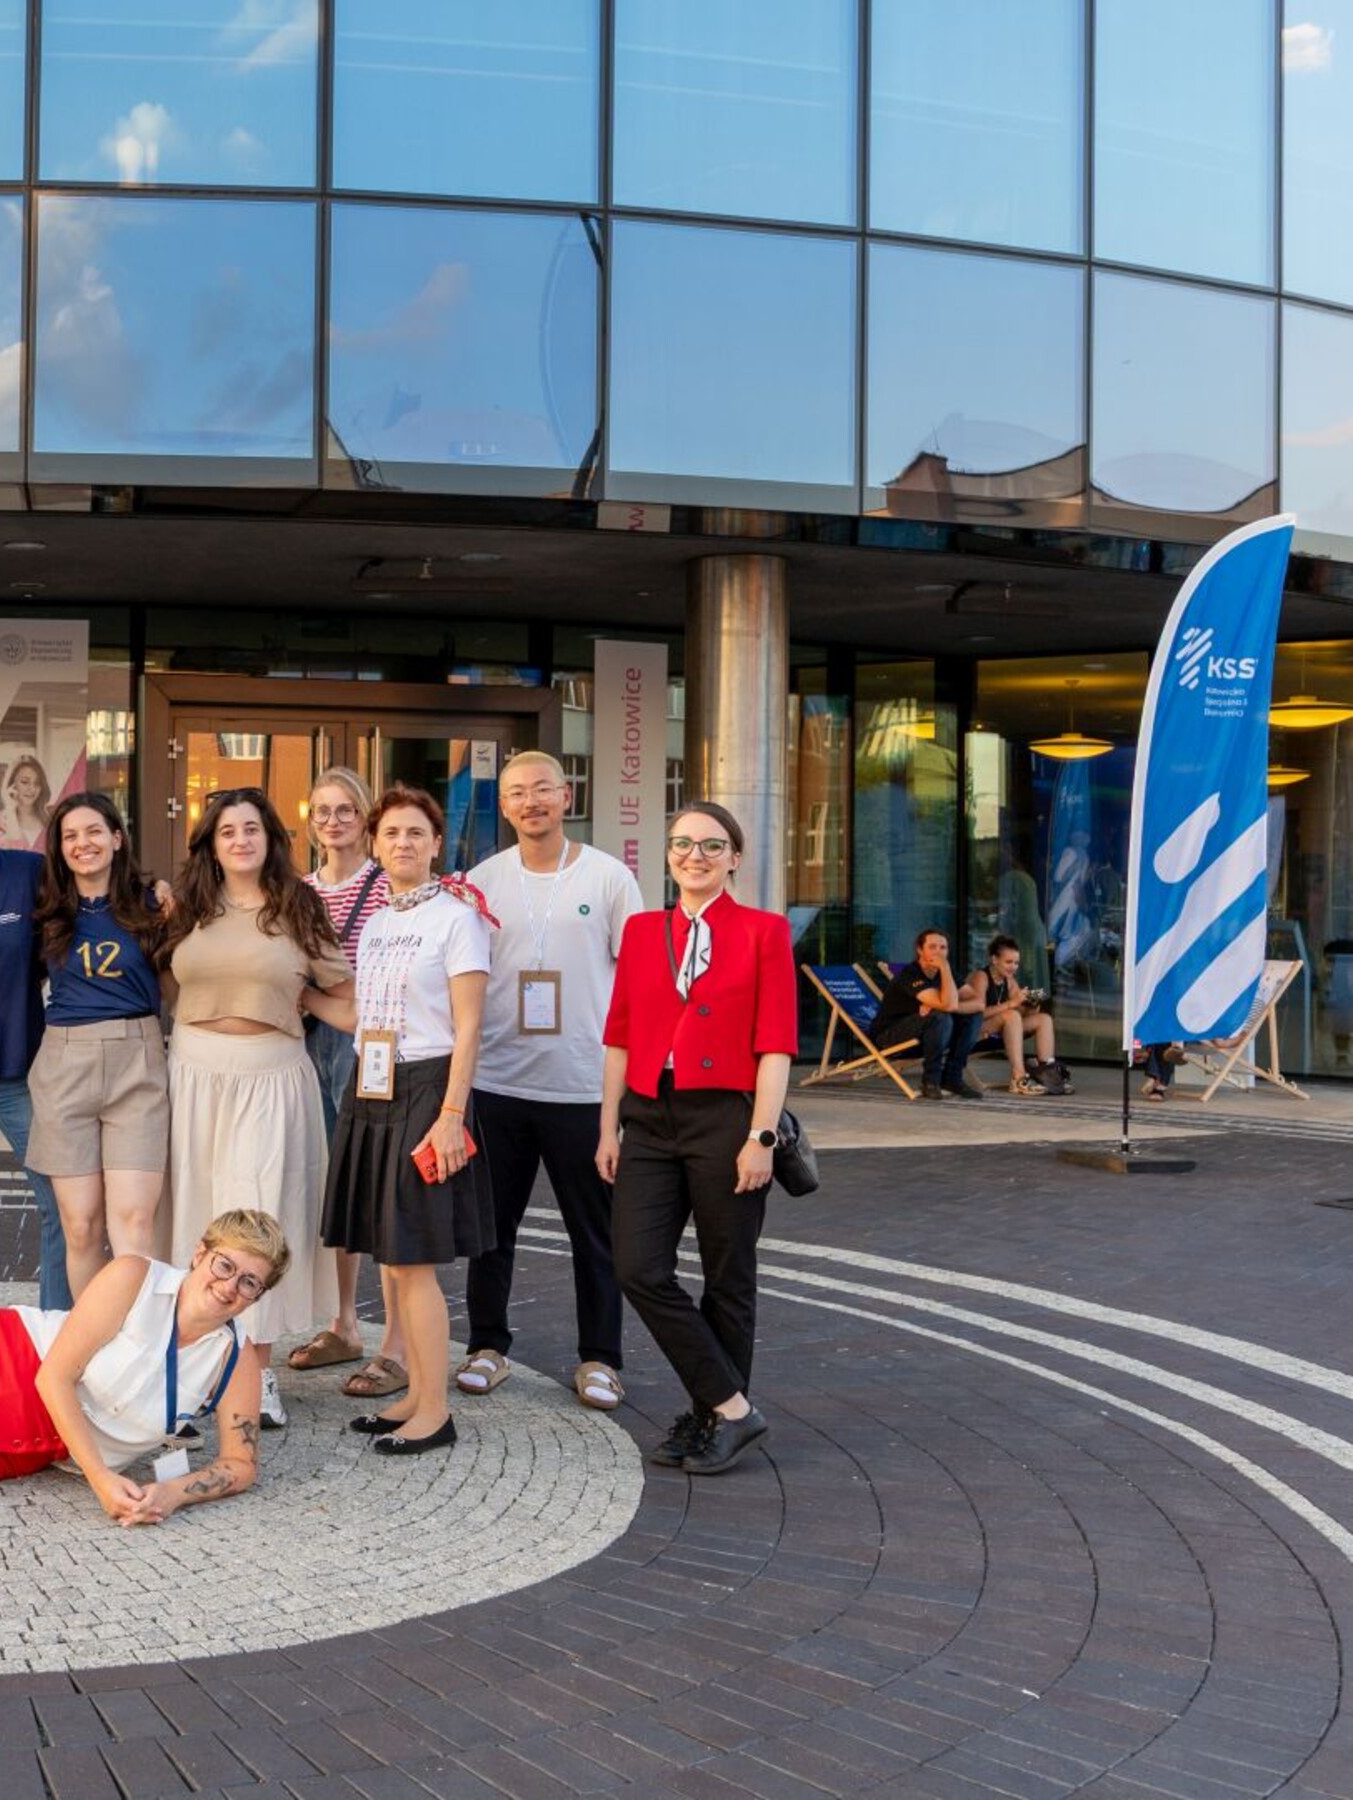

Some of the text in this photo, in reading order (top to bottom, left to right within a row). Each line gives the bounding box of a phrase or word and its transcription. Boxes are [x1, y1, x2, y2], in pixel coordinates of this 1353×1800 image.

[621, 667, 642, 784] Katowice
[620, 796, 640, 825] UE
[76, 941, 123, 978] 12
